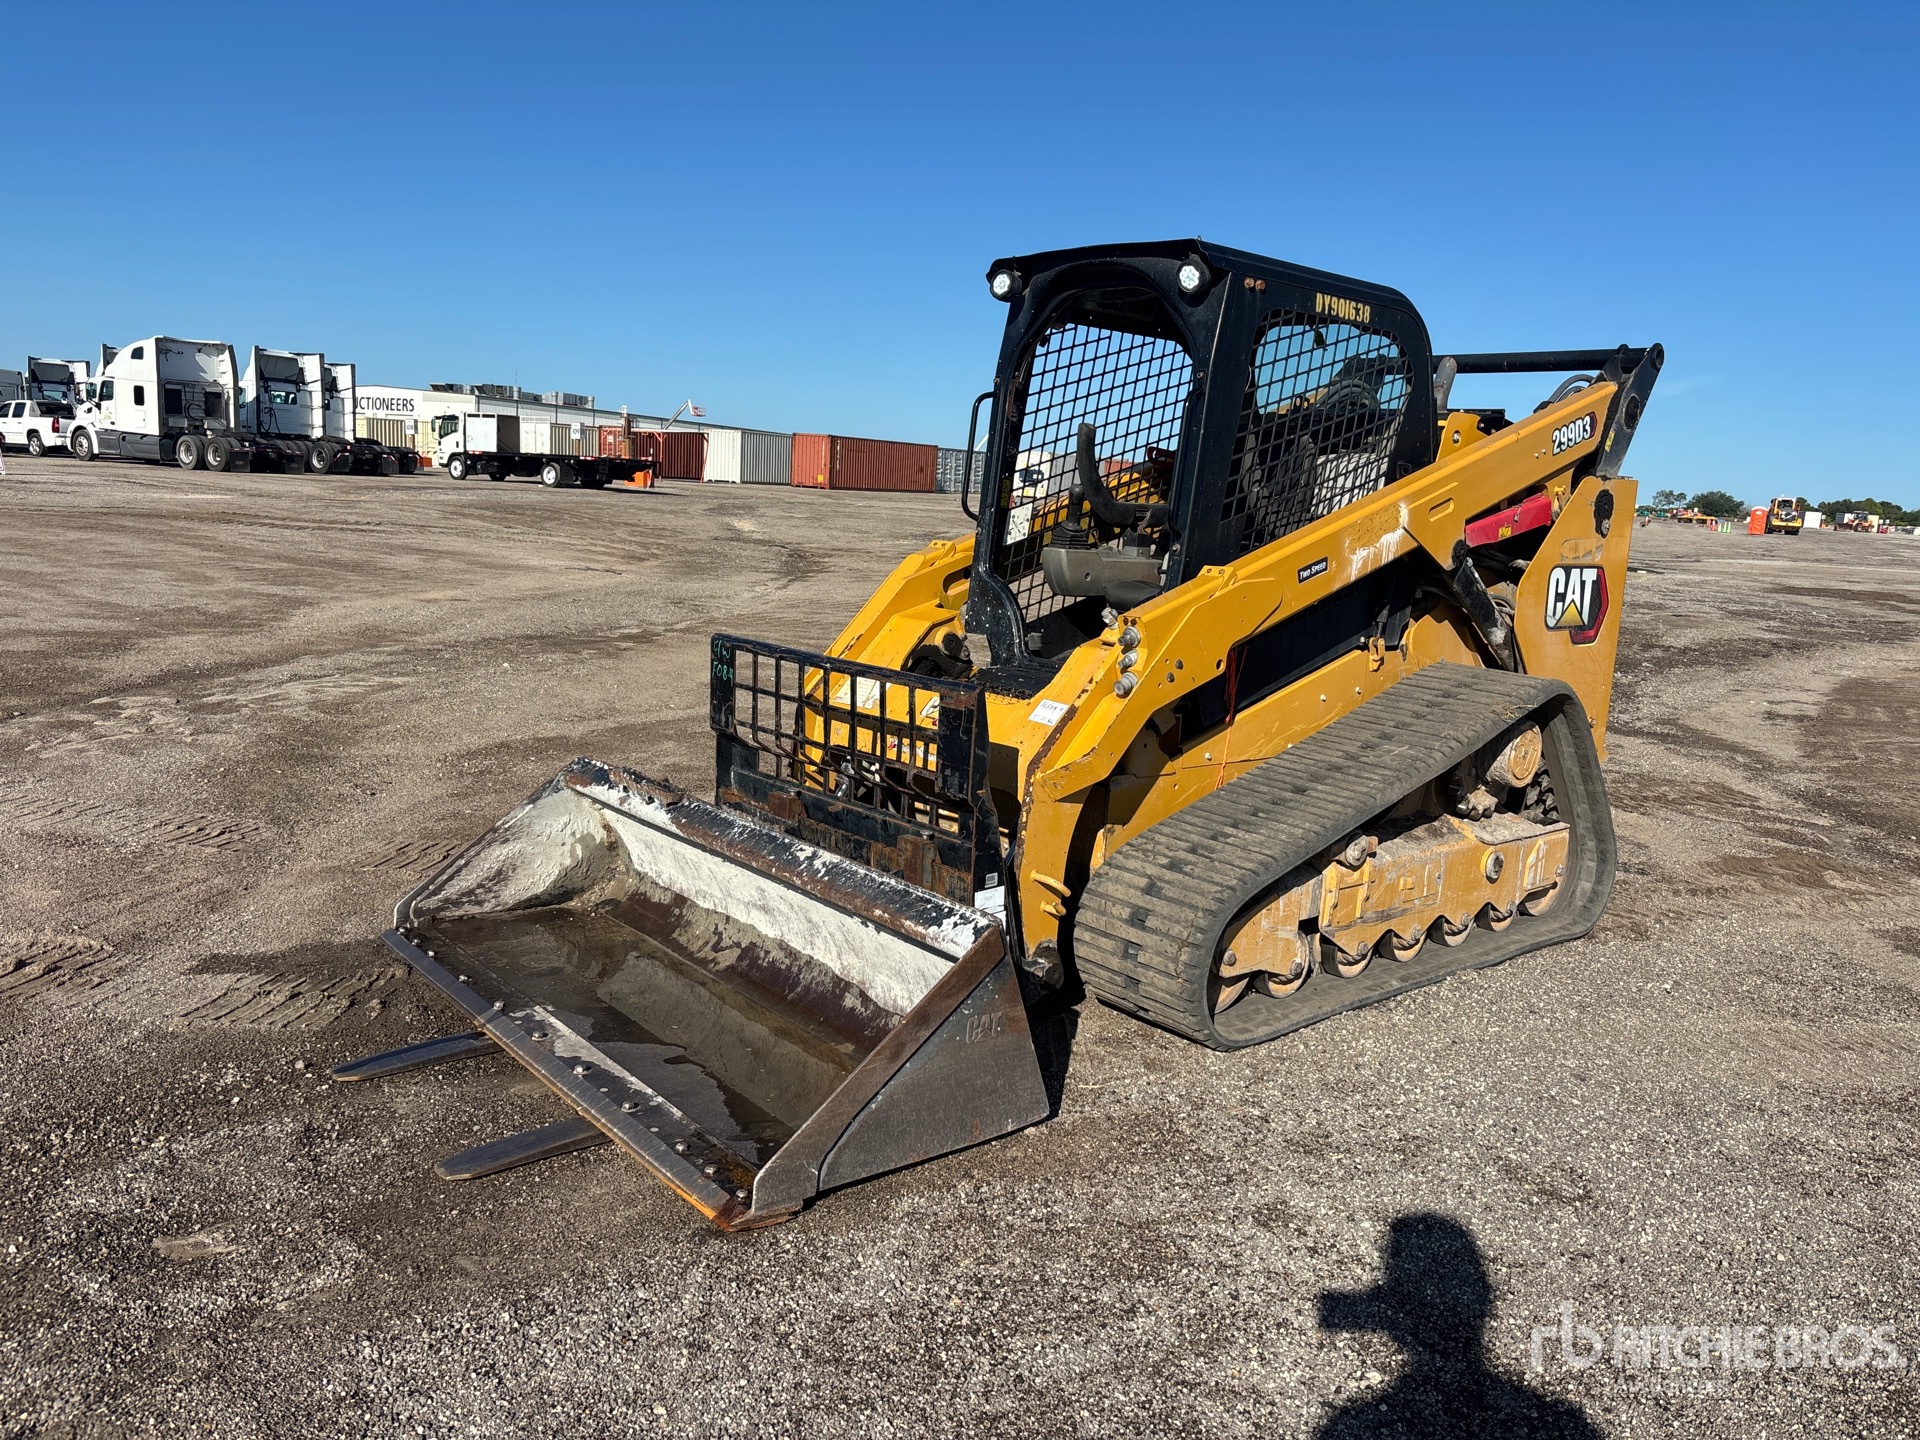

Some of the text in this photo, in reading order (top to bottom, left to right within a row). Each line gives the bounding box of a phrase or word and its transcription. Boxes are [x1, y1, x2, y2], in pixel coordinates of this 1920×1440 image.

[1315, 292, 1371, 324] DY901638
[1552, 415, 1591, 455] 299D3
[1546, 567, 1598, 628] CAT
